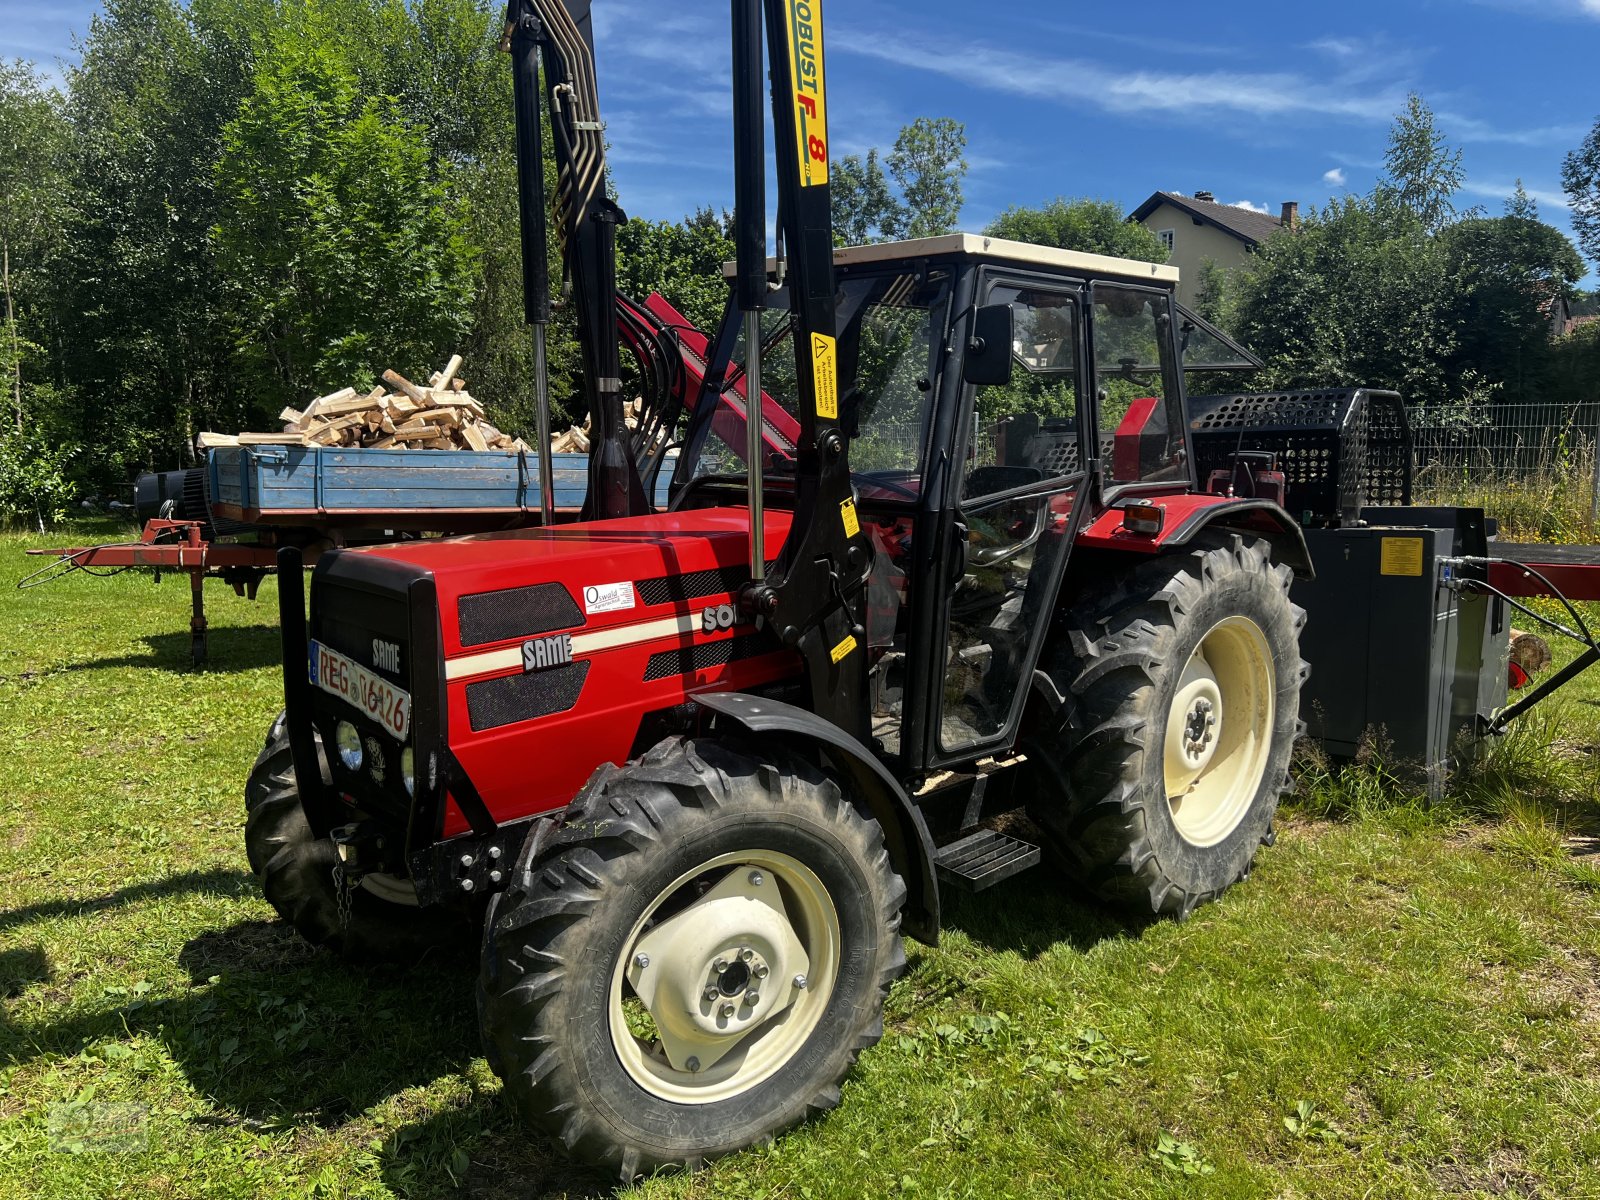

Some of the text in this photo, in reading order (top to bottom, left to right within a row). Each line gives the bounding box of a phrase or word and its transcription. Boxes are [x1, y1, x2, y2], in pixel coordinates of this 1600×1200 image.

[796, 0, 825, 162] OBUST F 8
[586, 587, 618, 604] Oswald
[704, 604, 745, 630] SOL
[373, 639, 399, 674] SAME
[523, 634, 572, 670] SAME
[320, 651, 349, 695] REG
